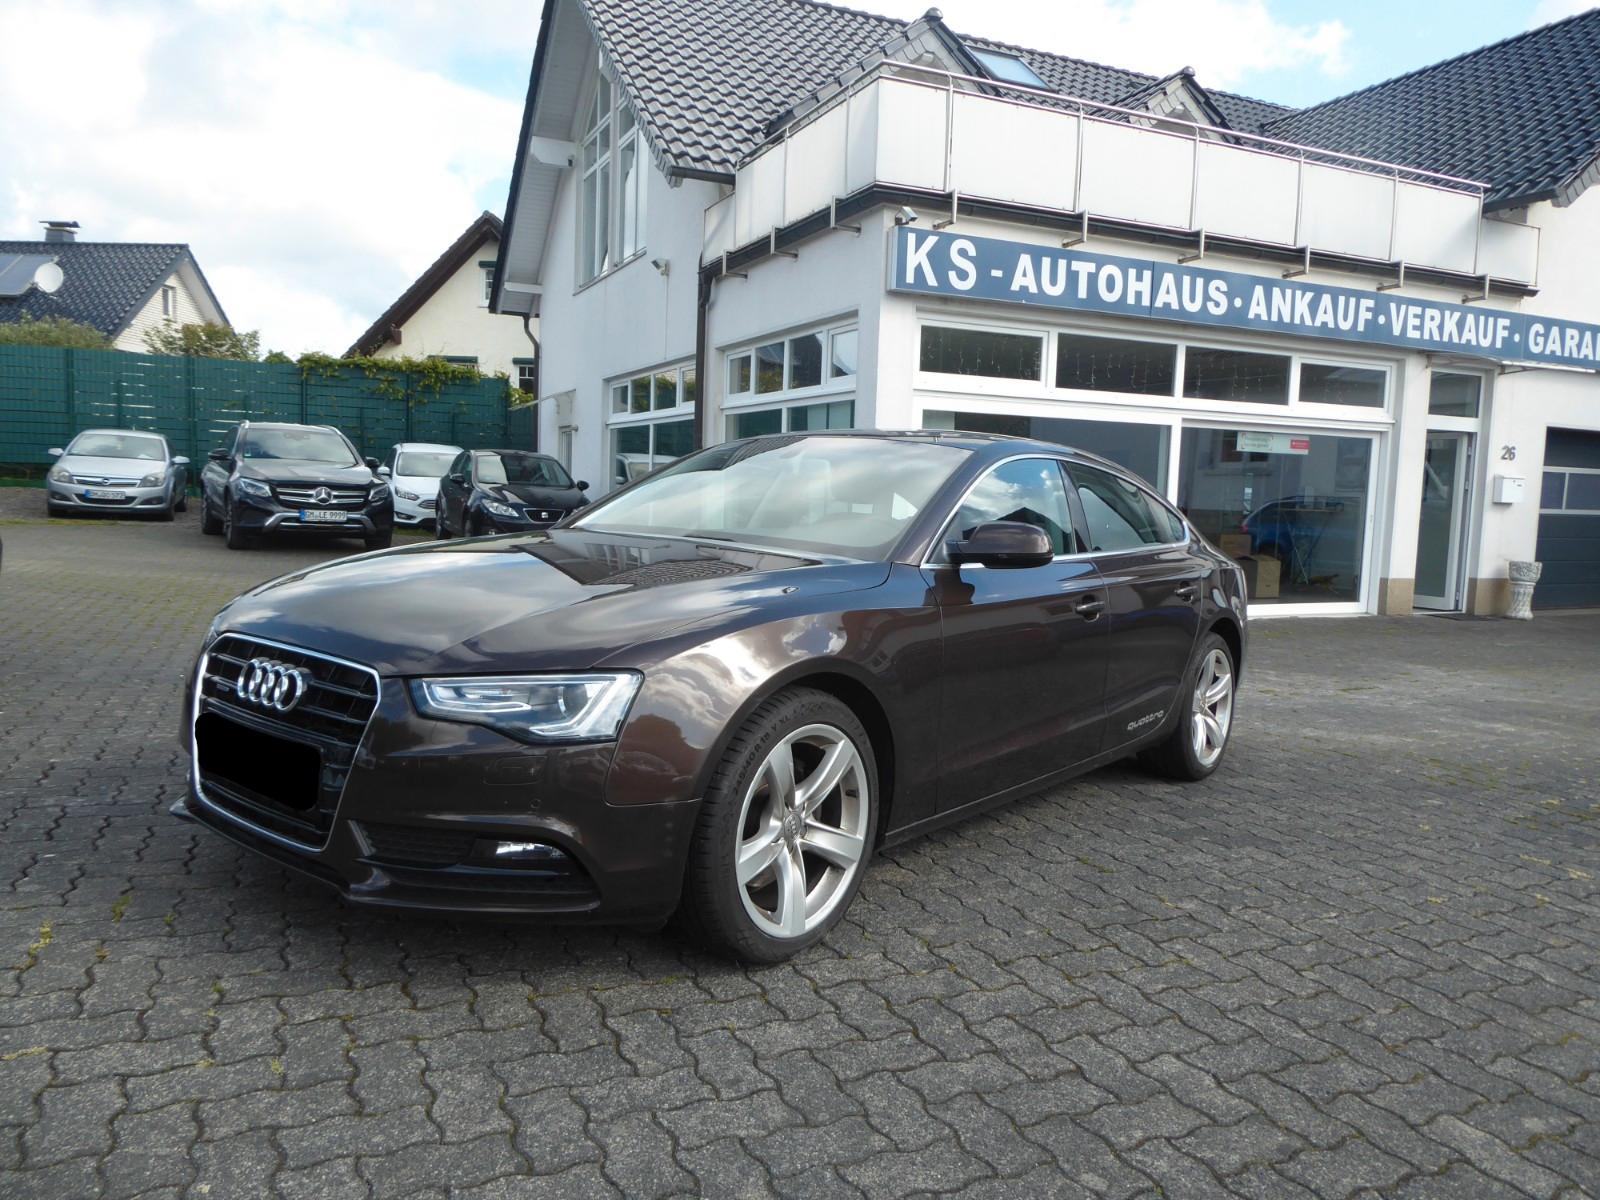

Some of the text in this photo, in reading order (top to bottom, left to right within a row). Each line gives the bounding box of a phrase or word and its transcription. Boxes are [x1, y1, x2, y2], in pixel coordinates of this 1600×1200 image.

[905, 232, 977, 291] KS
[1010, 253, 1228, 316] AUTOHAUS
[1248, 284, 1376, 332] ANKAUF
[1389, 302, 1511, 349] VERKAUF
[1500, 445, 1516, 461] 26
